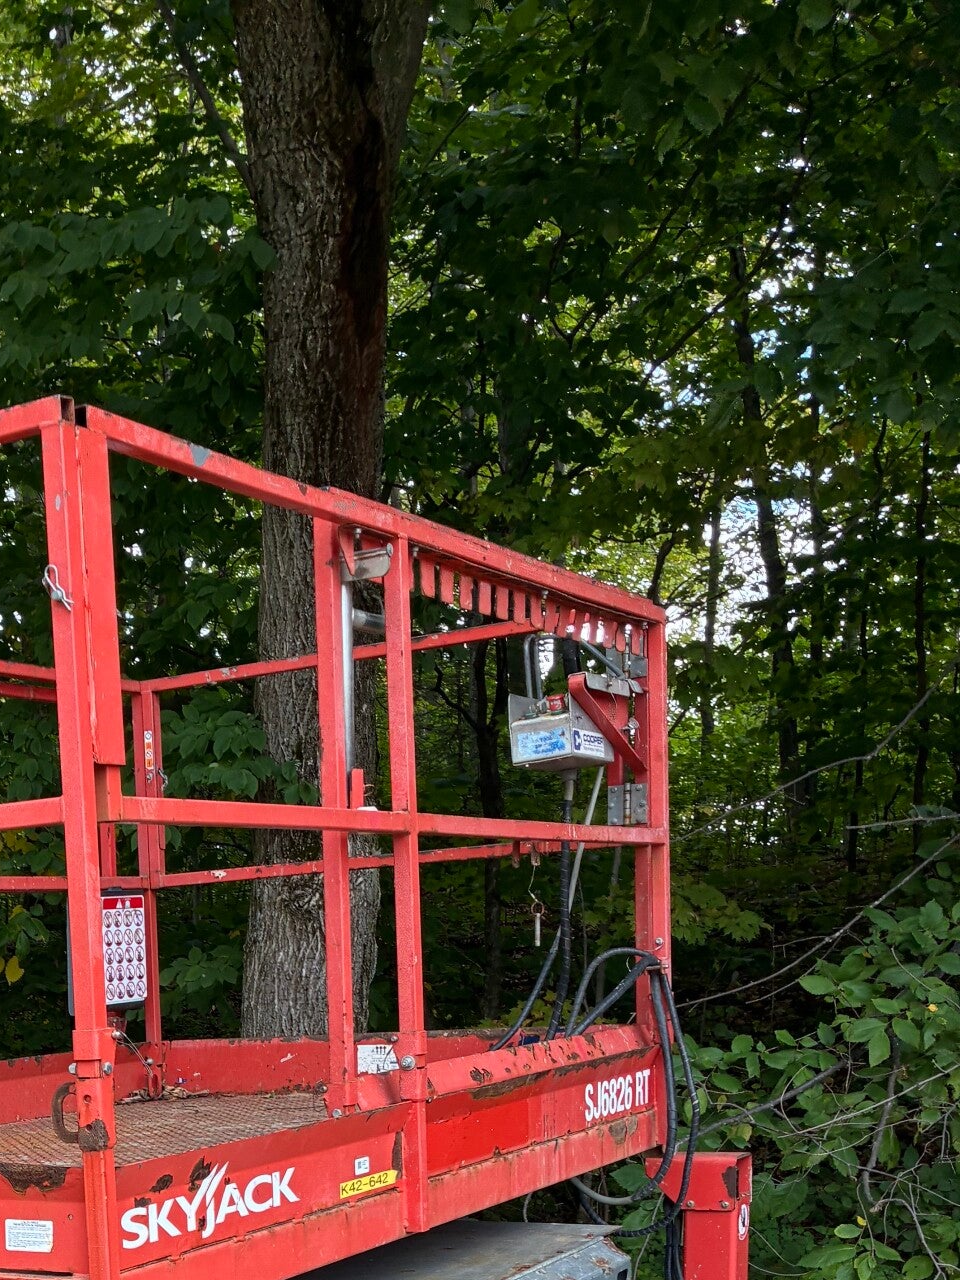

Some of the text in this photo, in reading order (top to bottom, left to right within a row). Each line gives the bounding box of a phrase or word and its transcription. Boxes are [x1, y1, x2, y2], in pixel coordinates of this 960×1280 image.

[584, 1068, 651, 1122] SJ6826 RT
[121, 1162, 300, 1251] SKYJACK
[341, 1172, 389, 1196] K42-642
